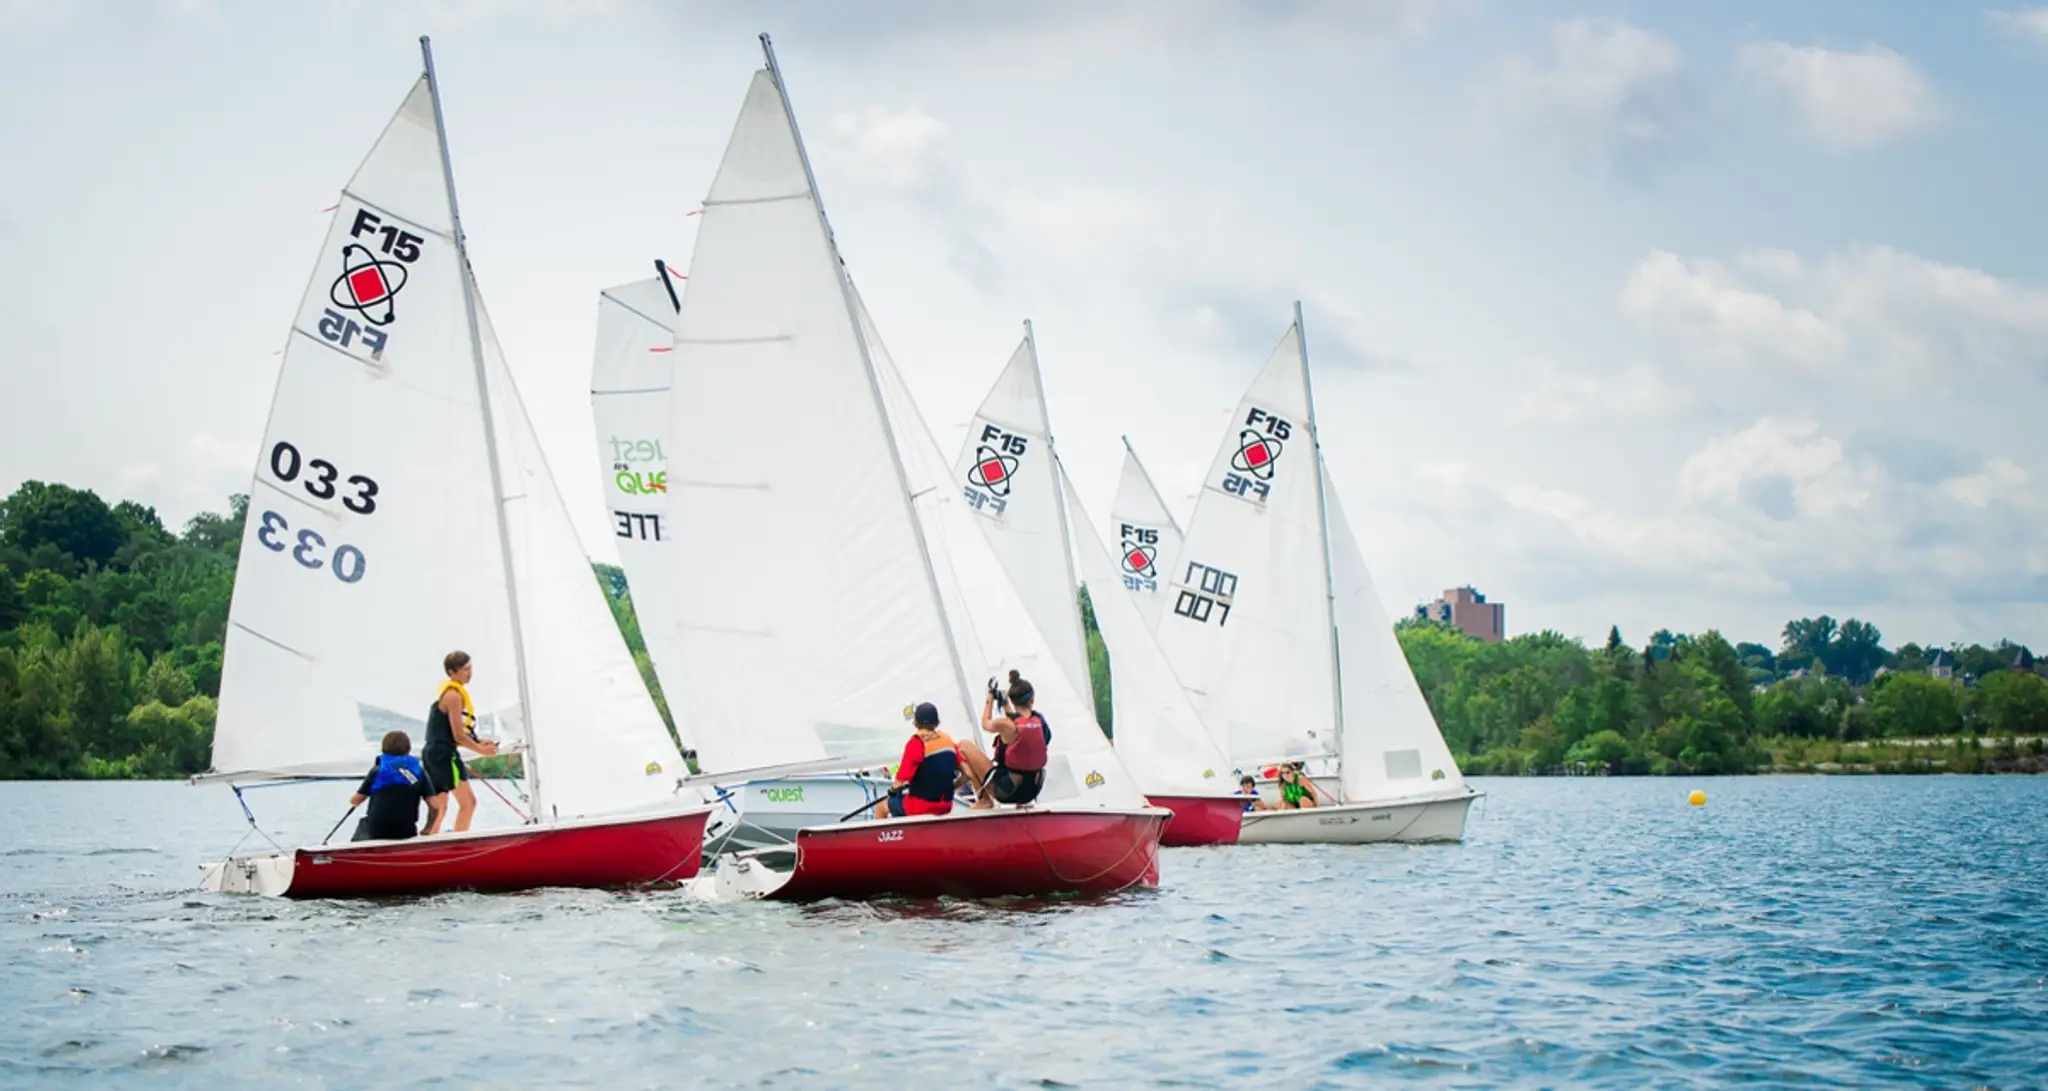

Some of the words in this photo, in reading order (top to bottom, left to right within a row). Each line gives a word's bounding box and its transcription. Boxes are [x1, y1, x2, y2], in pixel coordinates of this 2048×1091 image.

[351, 209, 424, 264] F15
[981, 424, 1028, 456] F15
[1245, 407, 1292, 441] F15
[270, 441, 379, 515] 033
[1121, 523, 1158, 545] F15
[1173, 590, 1231, 628] 007
[877, 829, 904, 843] JAZZ
